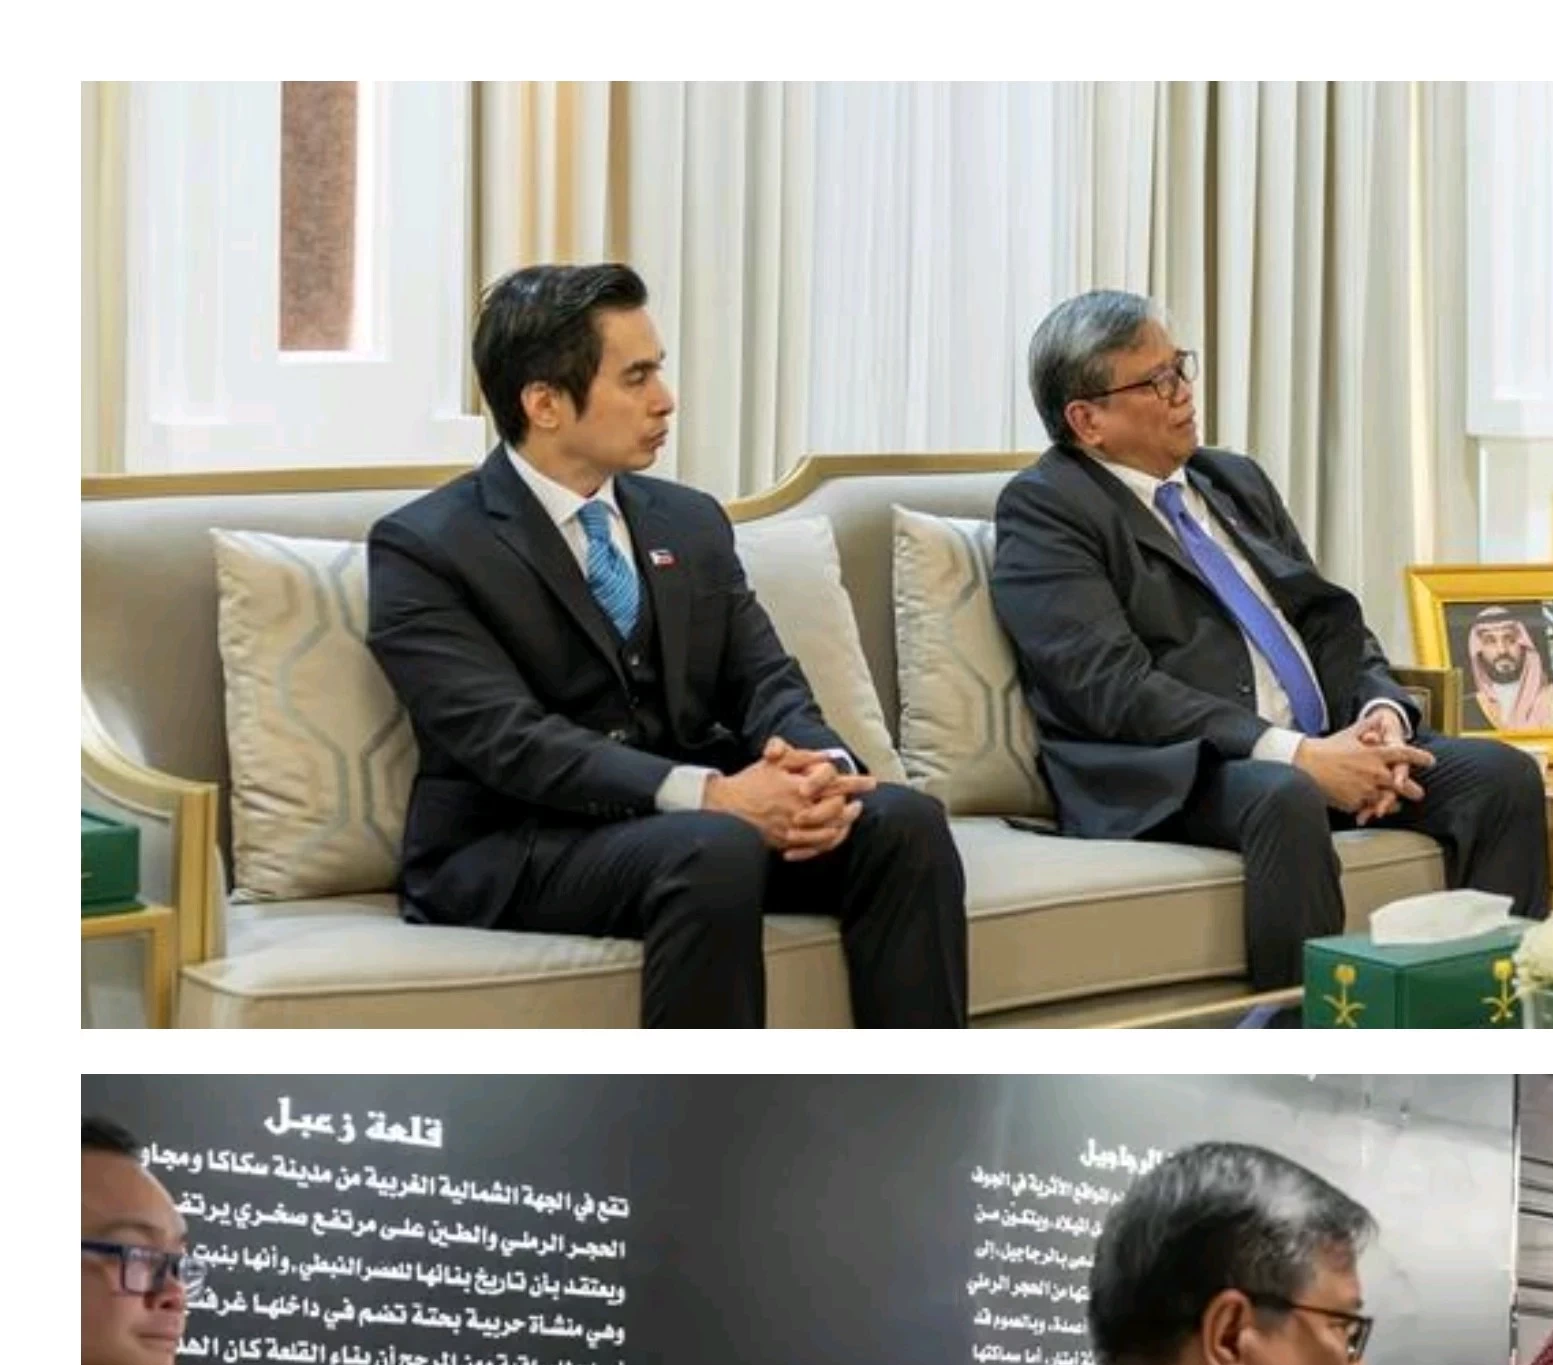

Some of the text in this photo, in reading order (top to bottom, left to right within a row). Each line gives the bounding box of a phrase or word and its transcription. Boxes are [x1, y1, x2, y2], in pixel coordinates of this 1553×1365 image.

[263, 1095, 443, 1148] قلعة زعبل
[140, 1142, 630, 1223] تقع في الجهة الشمالية الغربية من مدينة سكاكا ومجاو
[173, 1191, 626, 1262] الحجر الرملي والطين على مرتفع صخري يرتف
[474, 1266, 527, 1296] تاريخ
[529, 1271, 561, 1301] بأن
[563, 1276, 626, 1306] ويعتقد
[186, 1286, 248, 1317] غرف
[253, 1293, 320, 1320] داخلها
[323, 1297, 356, 1331] في
[358, 1302, 408, 1328] تضم
[411, 1302, 462, 1336] بحتة
[465, 1307, 526, 1339] حربية
[222, 1337, 263, 1363] كان
[266, 1337, 326, 1364] القلعة
[586, 1323, 626, 1349] وهي
